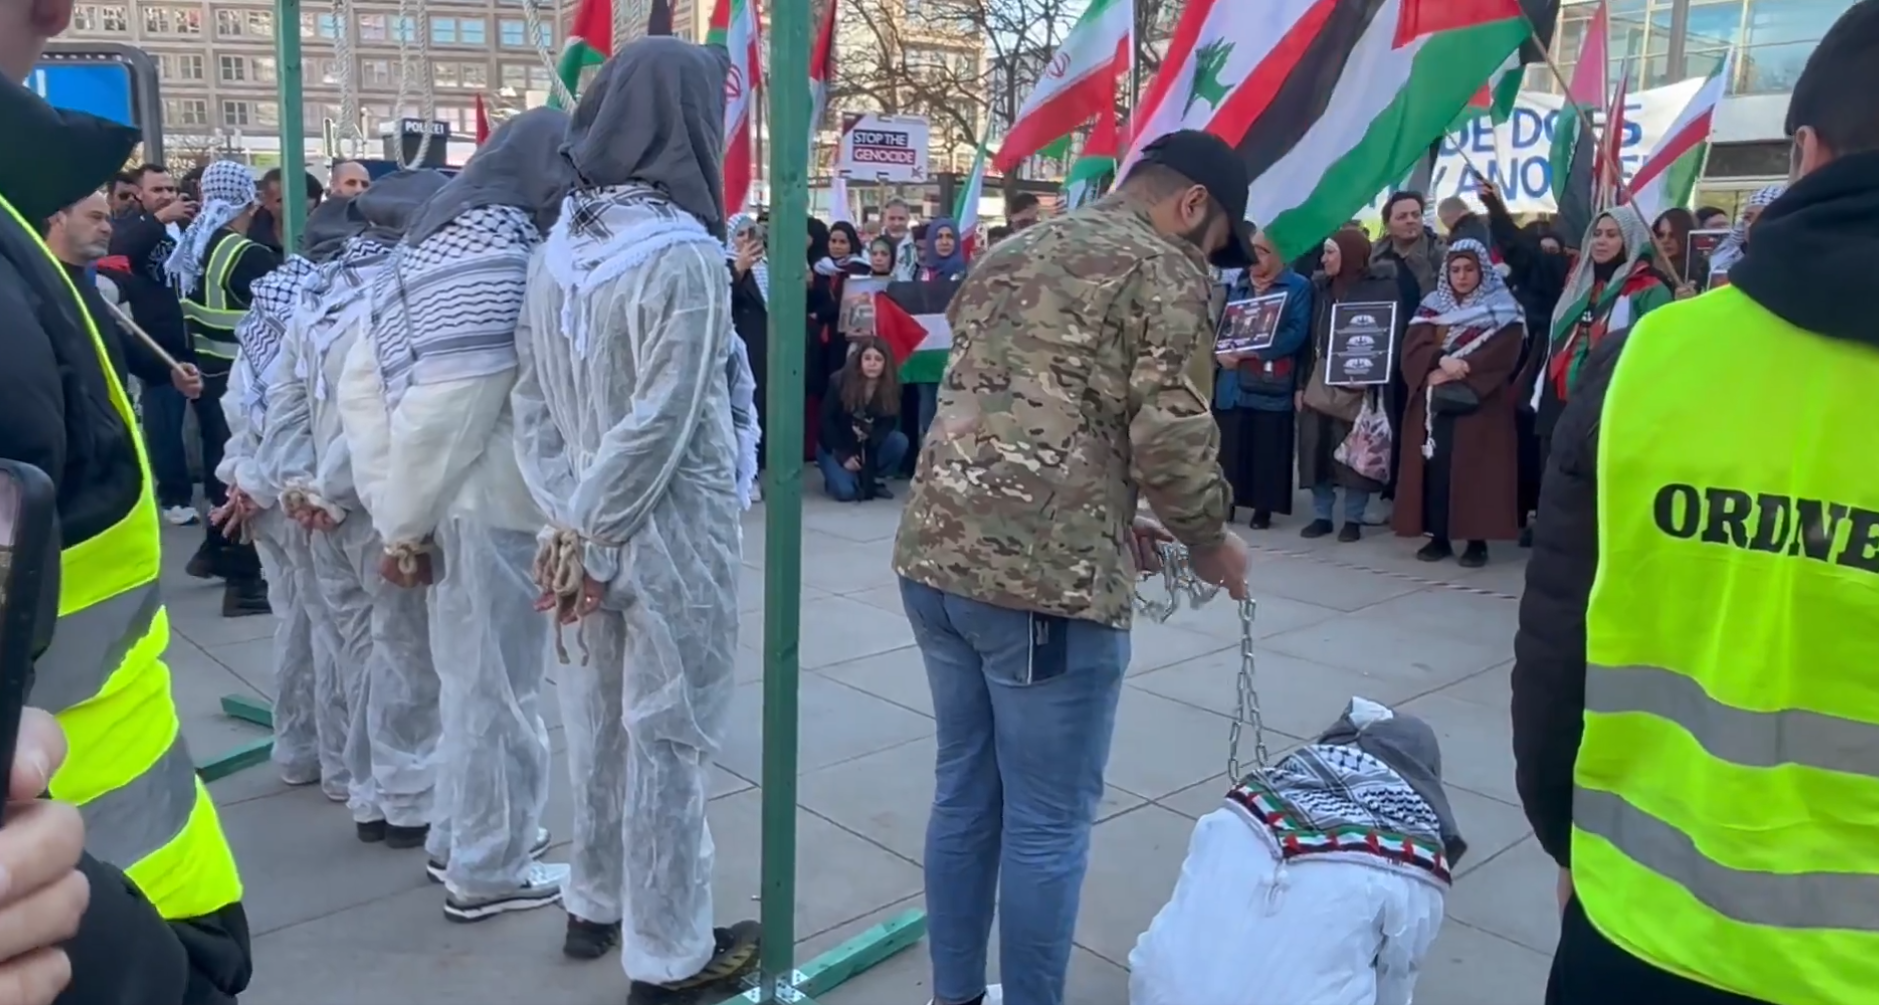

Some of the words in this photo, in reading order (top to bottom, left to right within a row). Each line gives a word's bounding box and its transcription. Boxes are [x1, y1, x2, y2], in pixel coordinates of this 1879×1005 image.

[405, 120, 444, 135] POLIEI
[854, 132, 883, 144] STOP
[884, 133, 906, 146] THE
[854, 148, 914, 163] GENOCIDE
